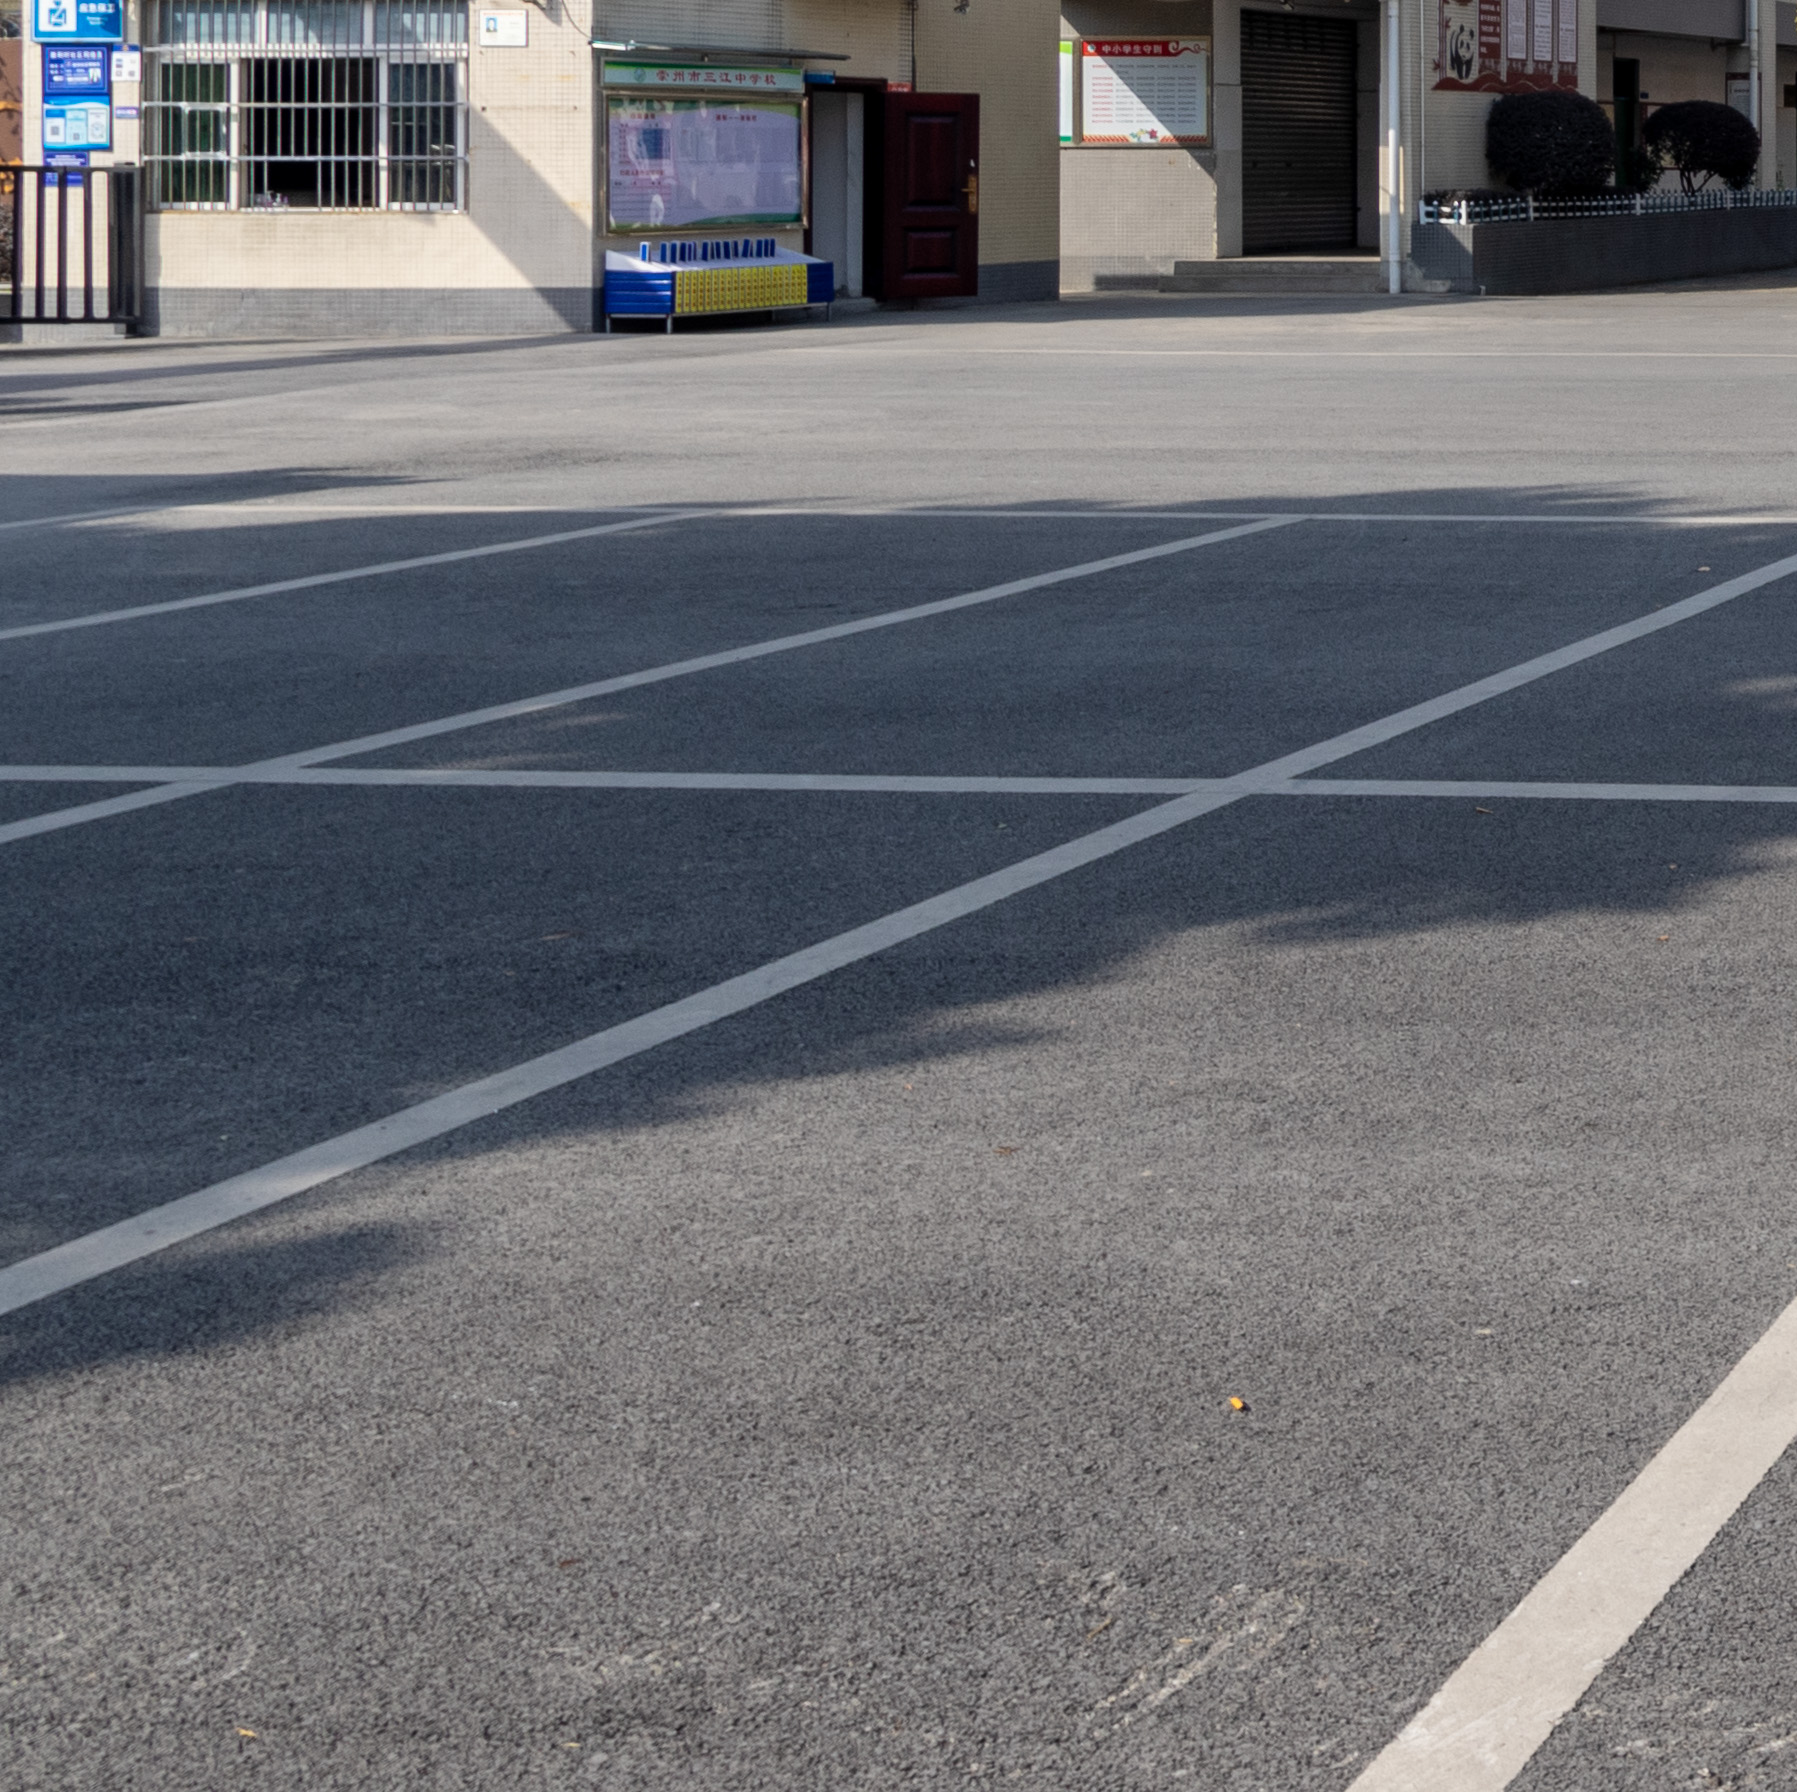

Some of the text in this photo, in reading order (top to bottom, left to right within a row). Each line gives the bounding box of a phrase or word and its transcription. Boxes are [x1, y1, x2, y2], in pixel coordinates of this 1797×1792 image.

[1102, 44, 1163, 55] 中小学生守则
[656, 69, 777, 86] 崇州市三江中学校
